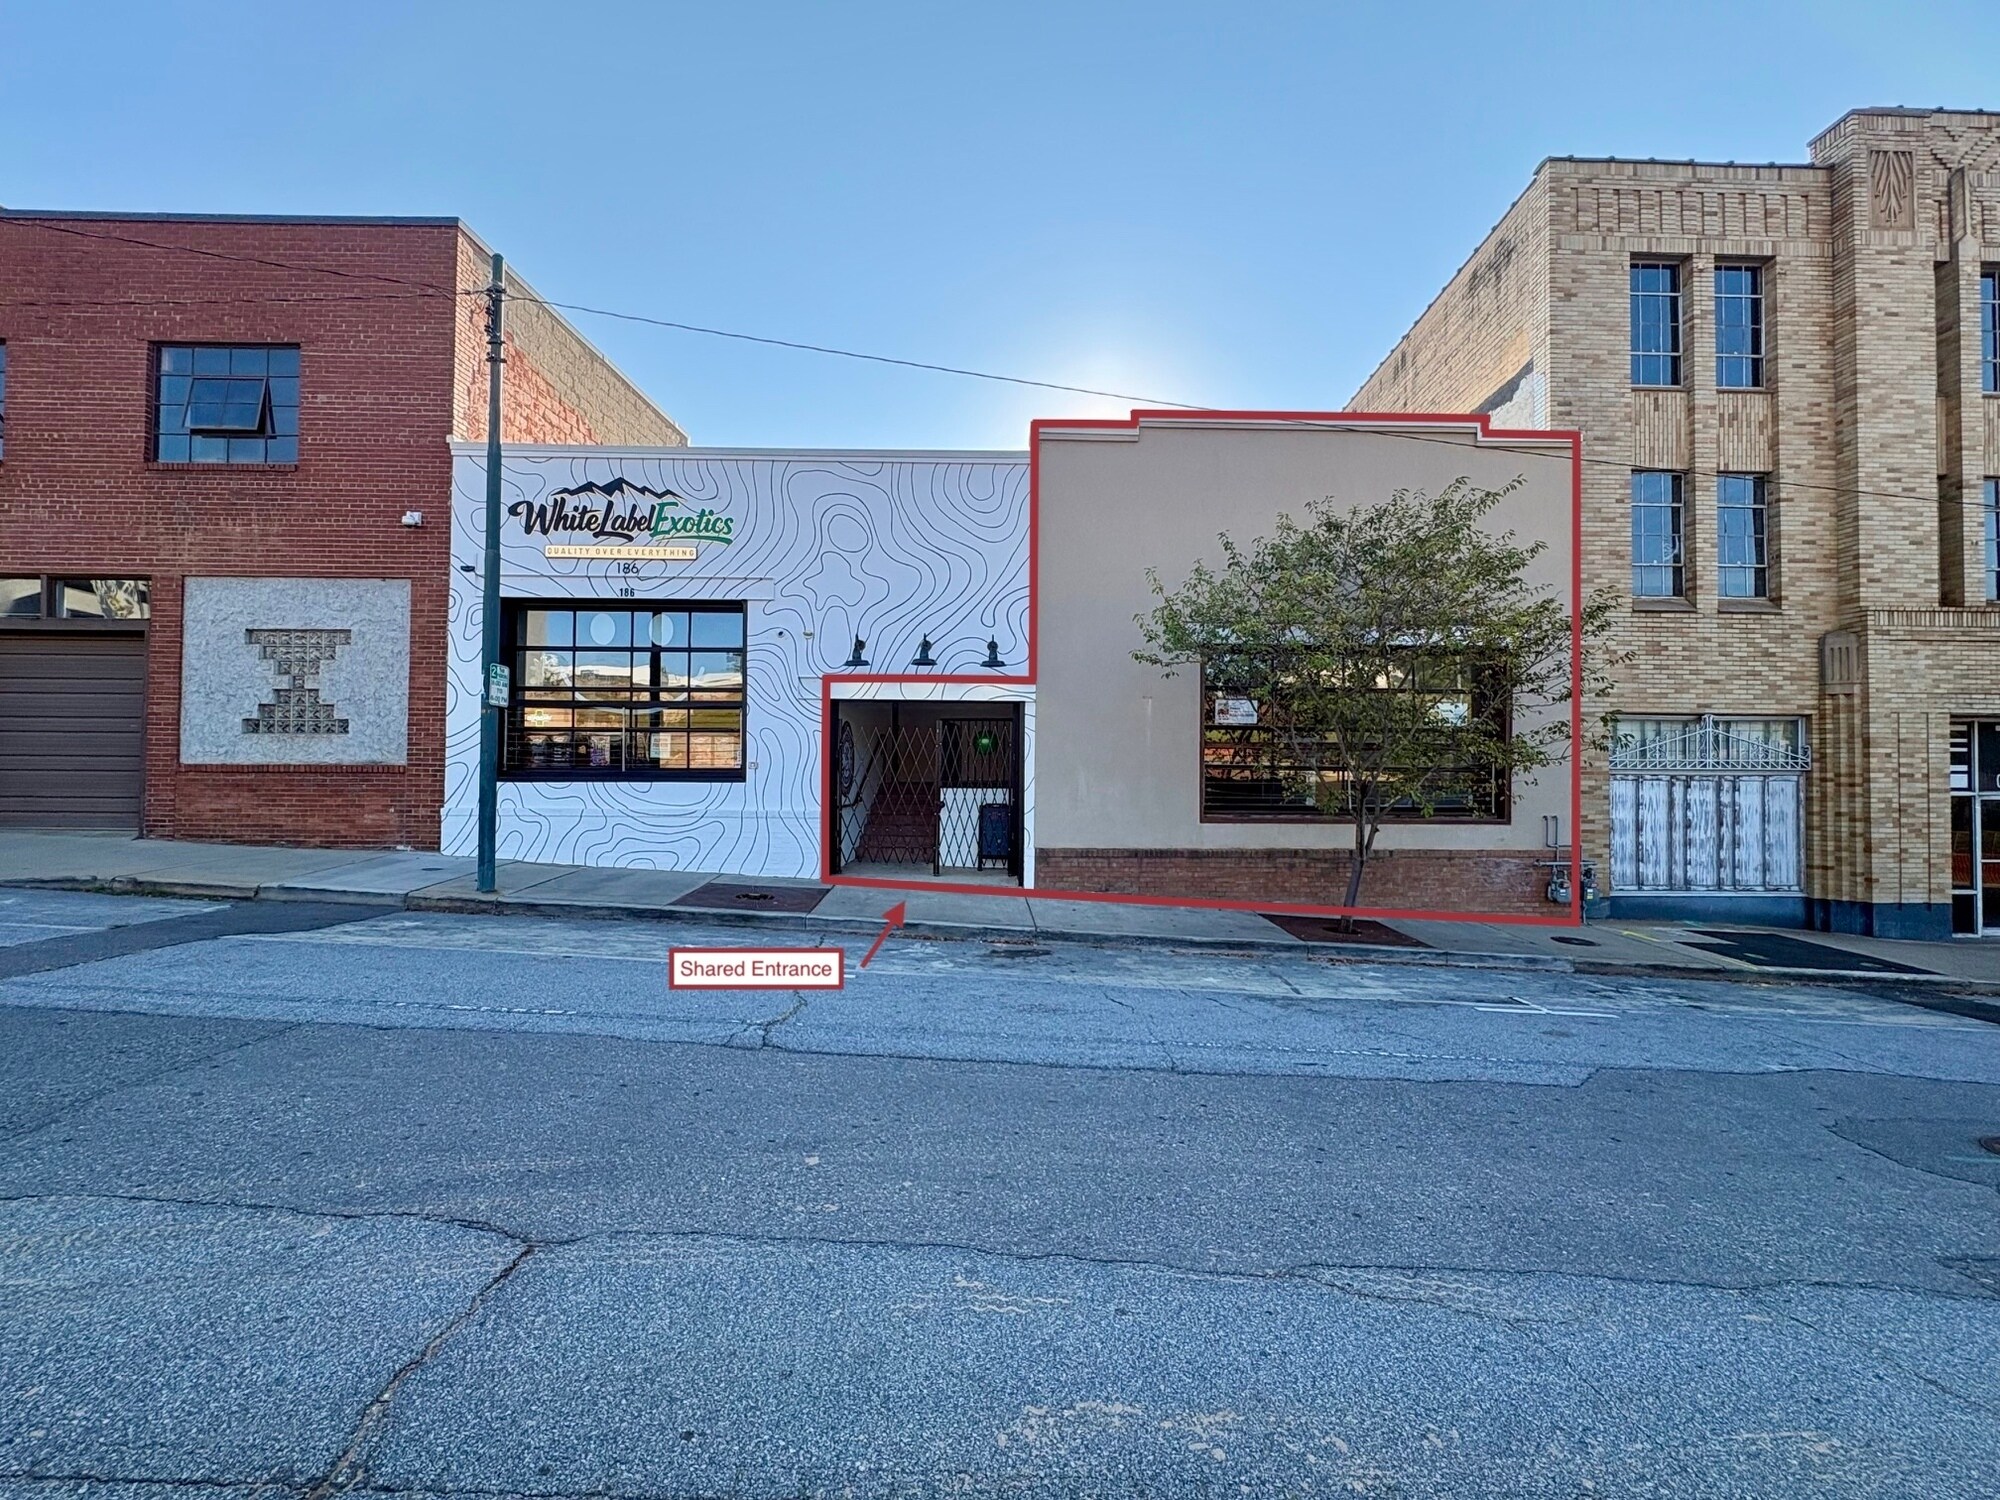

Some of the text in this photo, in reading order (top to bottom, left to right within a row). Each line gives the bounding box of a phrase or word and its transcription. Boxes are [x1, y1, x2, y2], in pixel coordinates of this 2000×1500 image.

[547, 547, 590, 555] QUALITY
[616, 562, 639, 574] 186
[619, 588, 635, 597] 186
